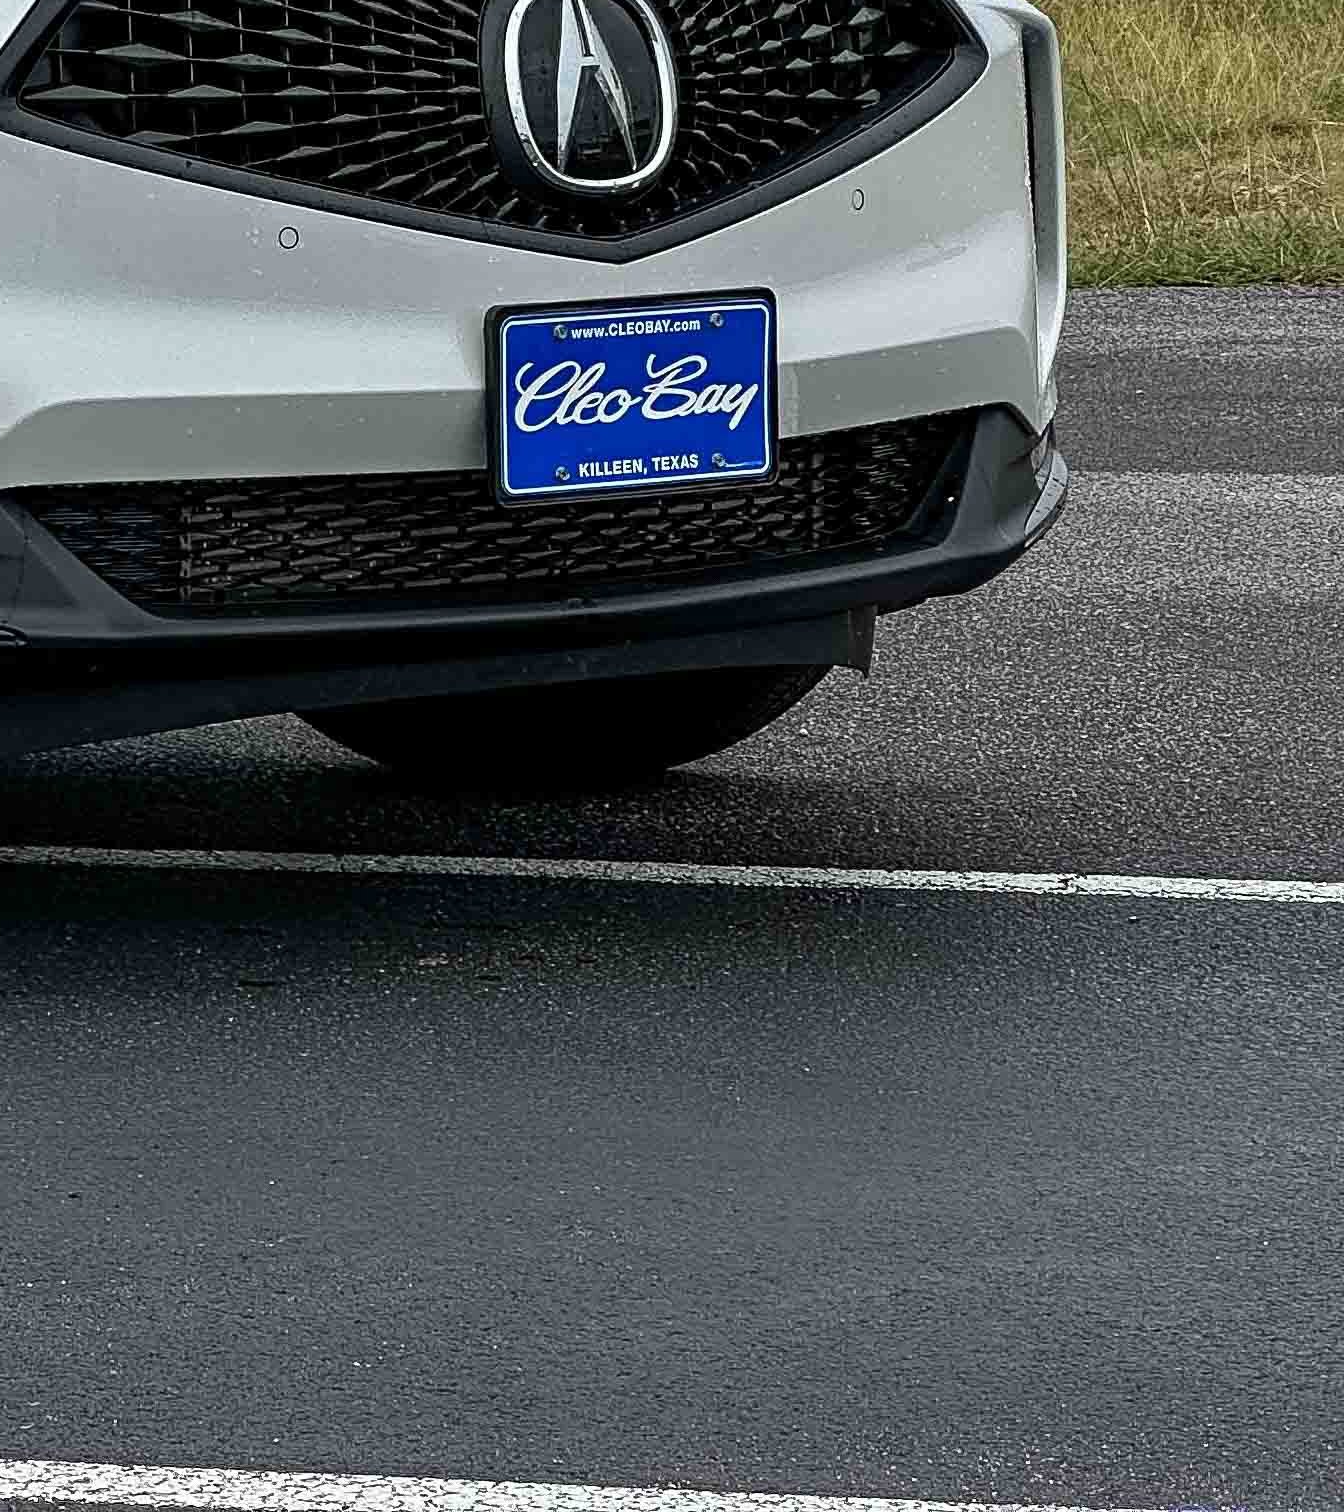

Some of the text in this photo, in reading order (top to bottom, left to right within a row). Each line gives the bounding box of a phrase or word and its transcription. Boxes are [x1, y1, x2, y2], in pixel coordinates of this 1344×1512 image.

[570, 318, 701, 340] www.CLEOBAY.com
[514, 353, 759, 433] Cleo Bay
[578, 453, 699, 478] KILLEEN, TEXAS
